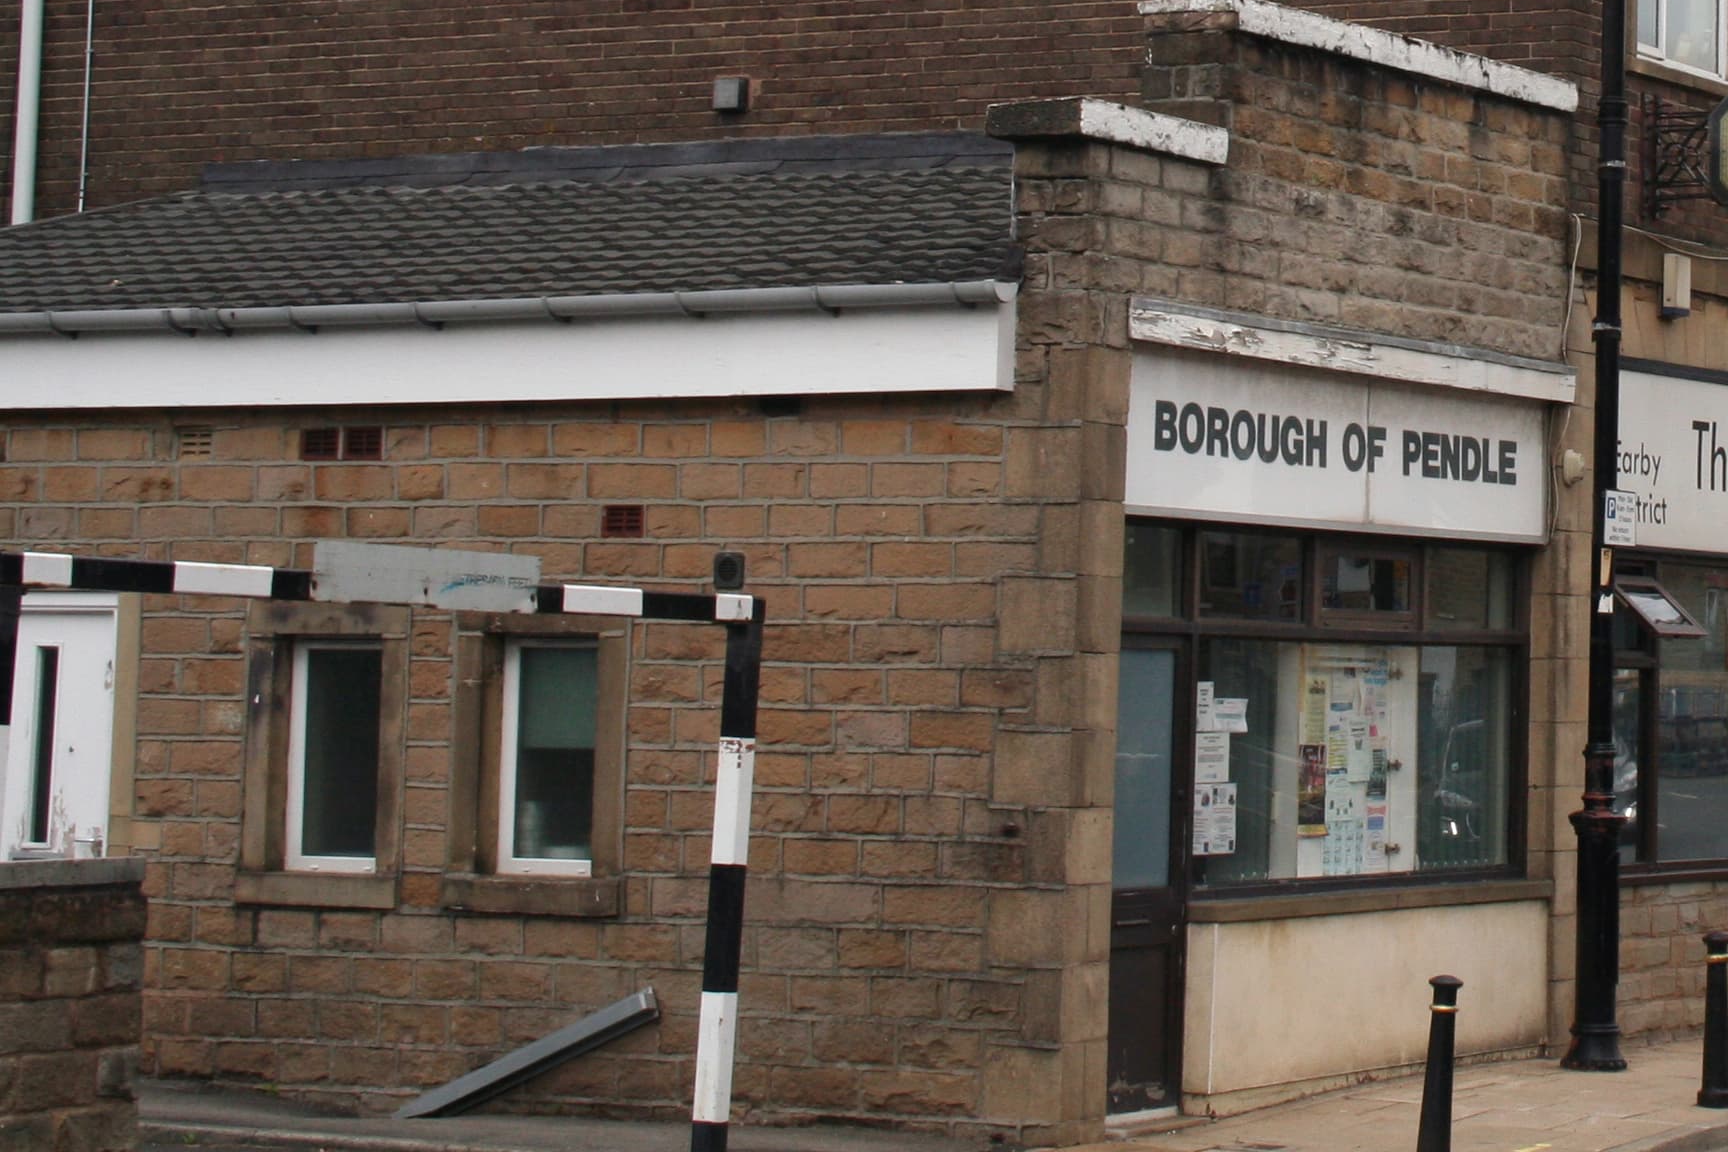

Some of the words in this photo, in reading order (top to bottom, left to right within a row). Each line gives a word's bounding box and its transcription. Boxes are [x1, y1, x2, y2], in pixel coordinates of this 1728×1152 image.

[1154, 399, 1328, 469] BOROUGH
[1342, 422, 1388, 473] OF
[1402, 429, 1518, 485] PENDLE
[1636, 493, 1668, 525] trict
